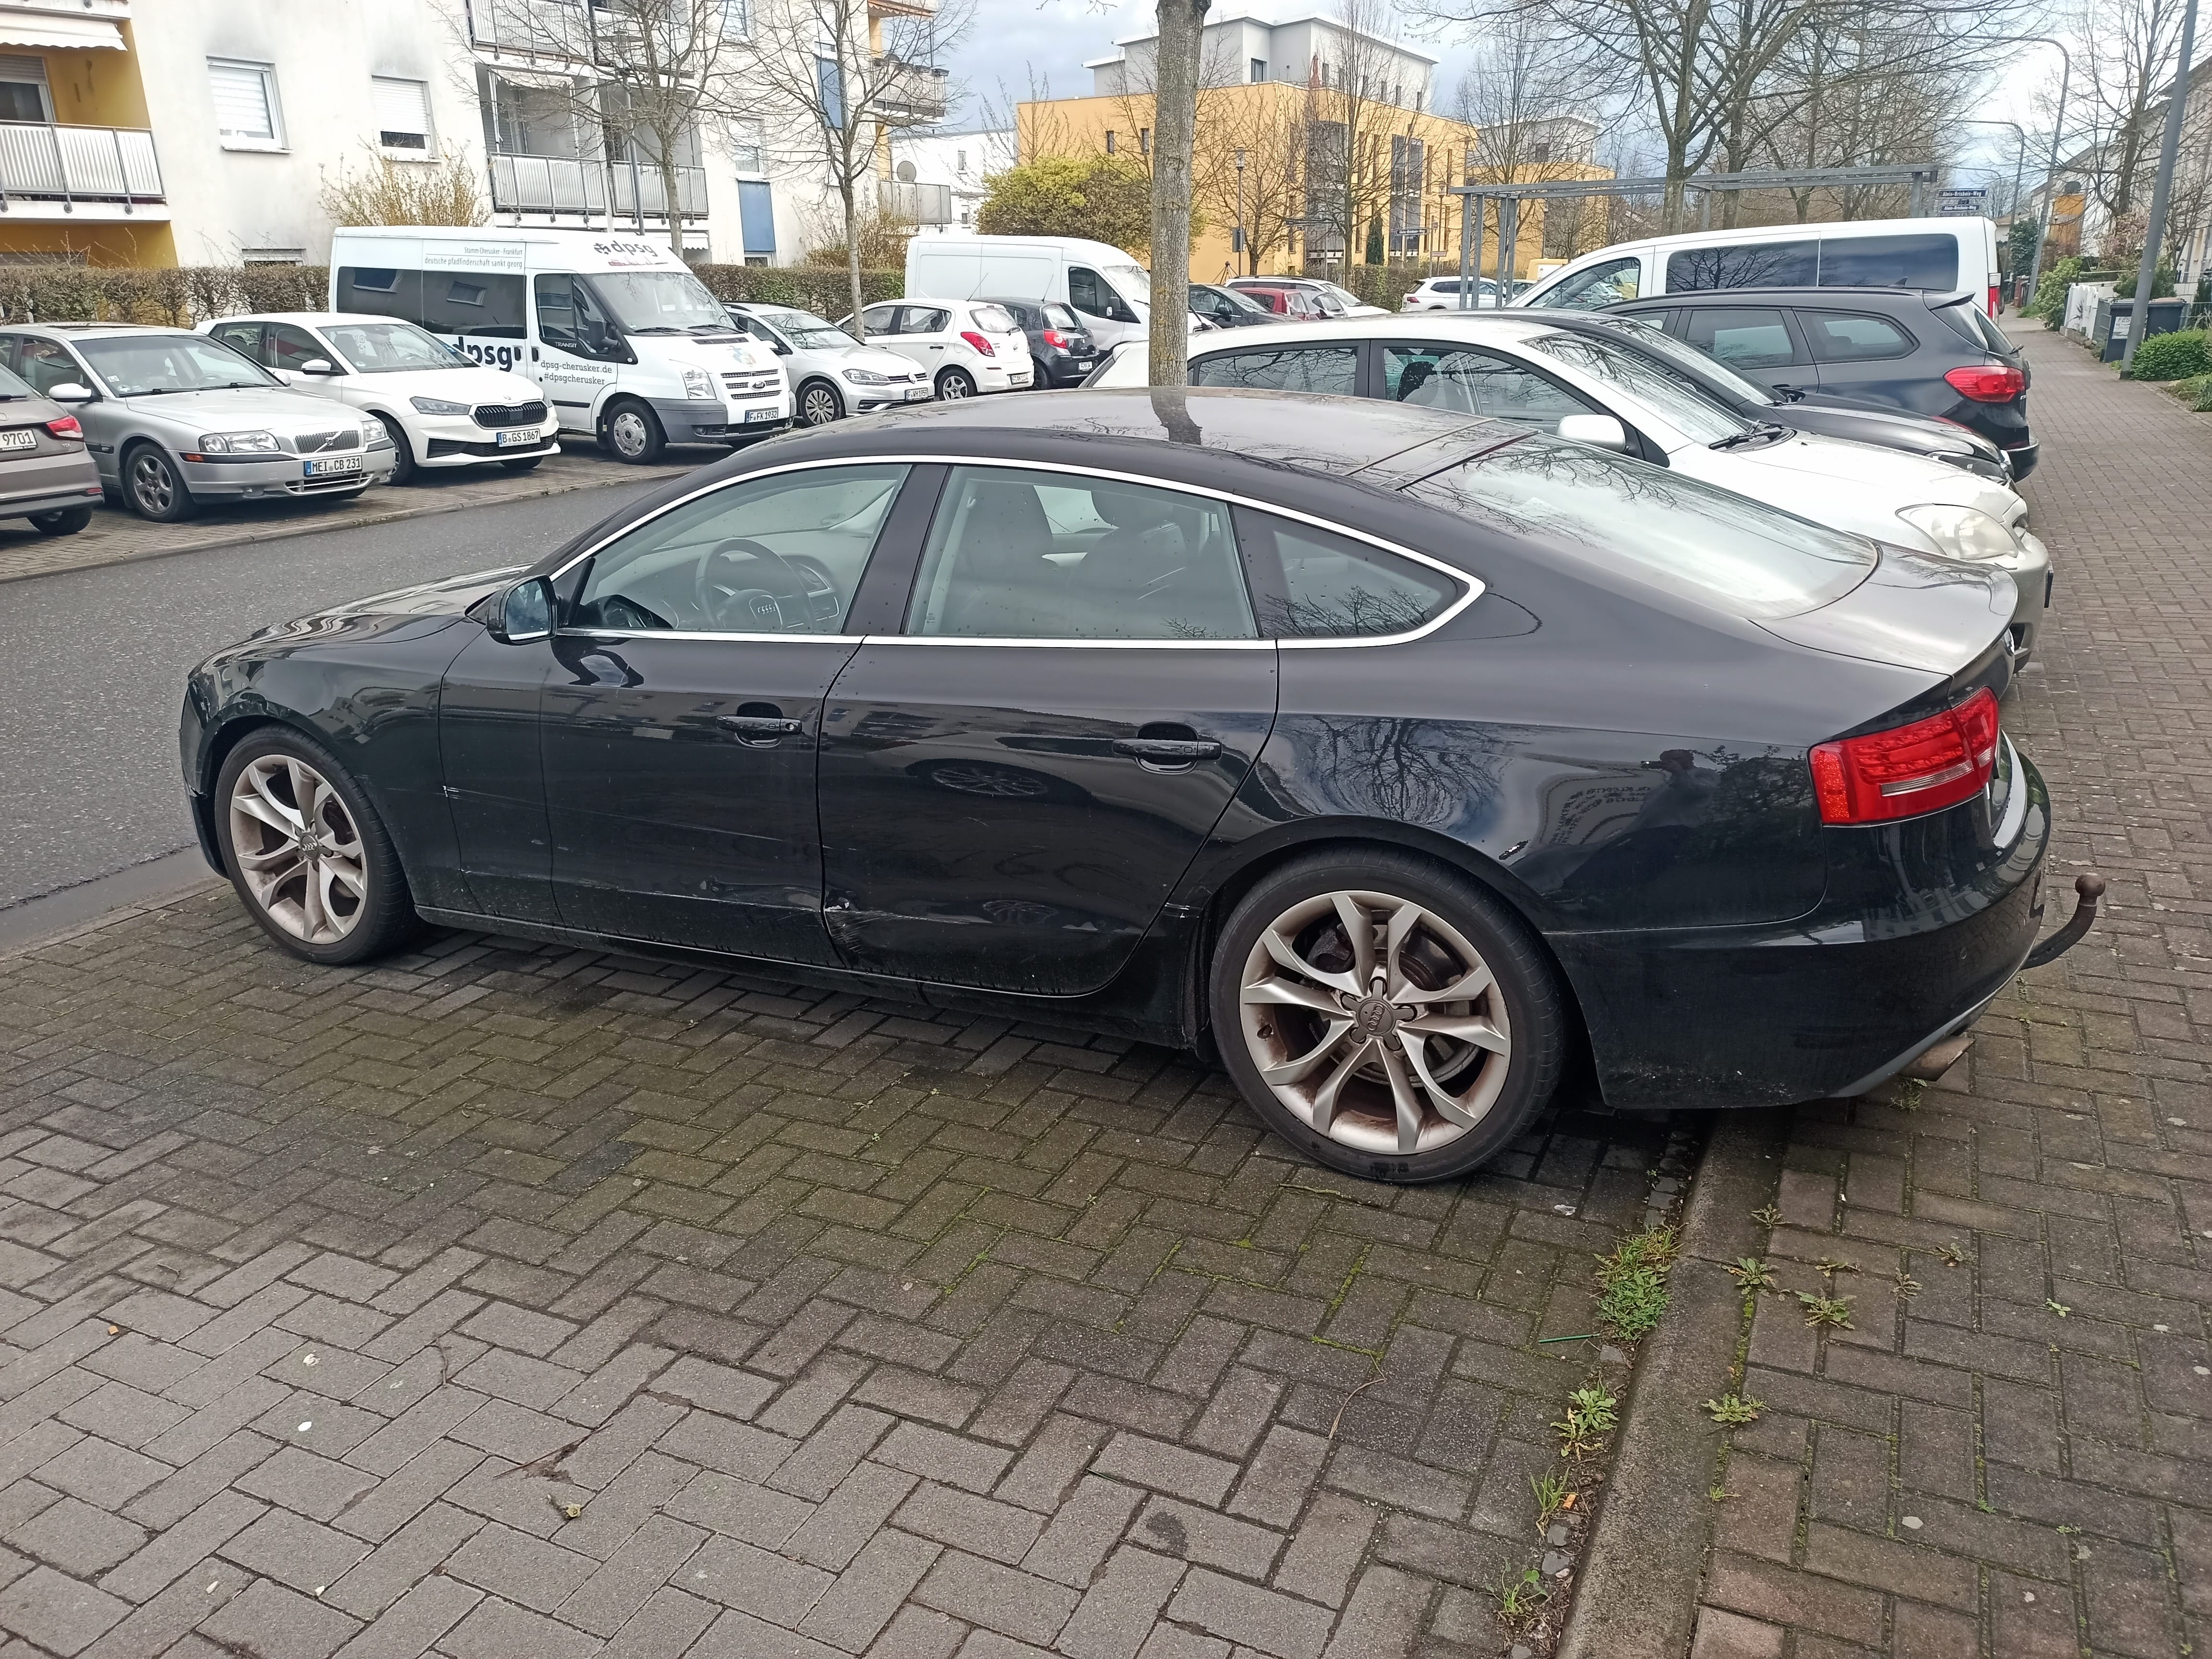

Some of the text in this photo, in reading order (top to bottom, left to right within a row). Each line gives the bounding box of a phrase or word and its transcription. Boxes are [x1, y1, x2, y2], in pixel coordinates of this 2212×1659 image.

[611, 240, 658, 257] dpsg
[448, 257, 490, 266] pfadfinderschaft
[541, 360, 612, 373] dpsg-cherusker.de
[544, 372, 605, 385] #dpsgcherusker
[750, 413, 754, 421] F
[2, 432, 34, 445] 9701
[502, 434, 507, 443] B
[313, 461, 327, 472] MEI
[334, 460, 344, 470] CB
[347, 457, 361, 469] 231
